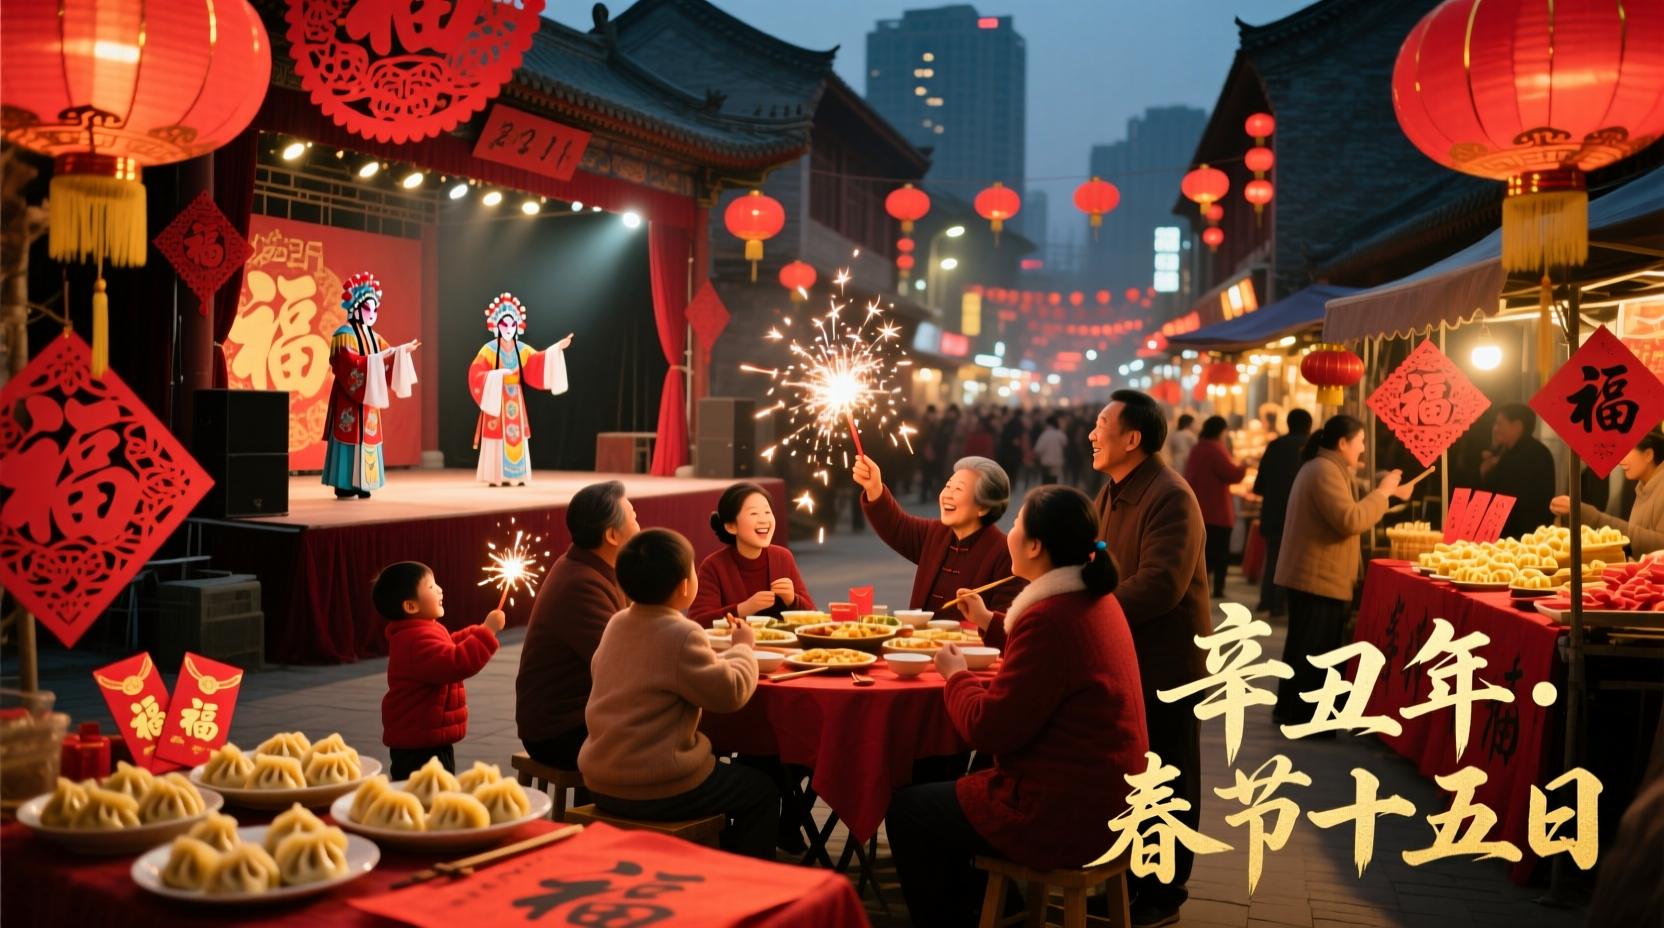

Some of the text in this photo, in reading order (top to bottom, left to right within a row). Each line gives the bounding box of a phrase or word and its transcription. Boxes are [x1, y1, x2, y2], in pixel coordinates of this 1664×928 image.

[184, 222, 224, 268] 福
[228, 270, 330, 398] 福
[1402, 372, 1454, 427] 福
[1566, 364, 1639, 434] 福
[0, 395, 140, 545] 福
[180, 698, 218, 742] 福
